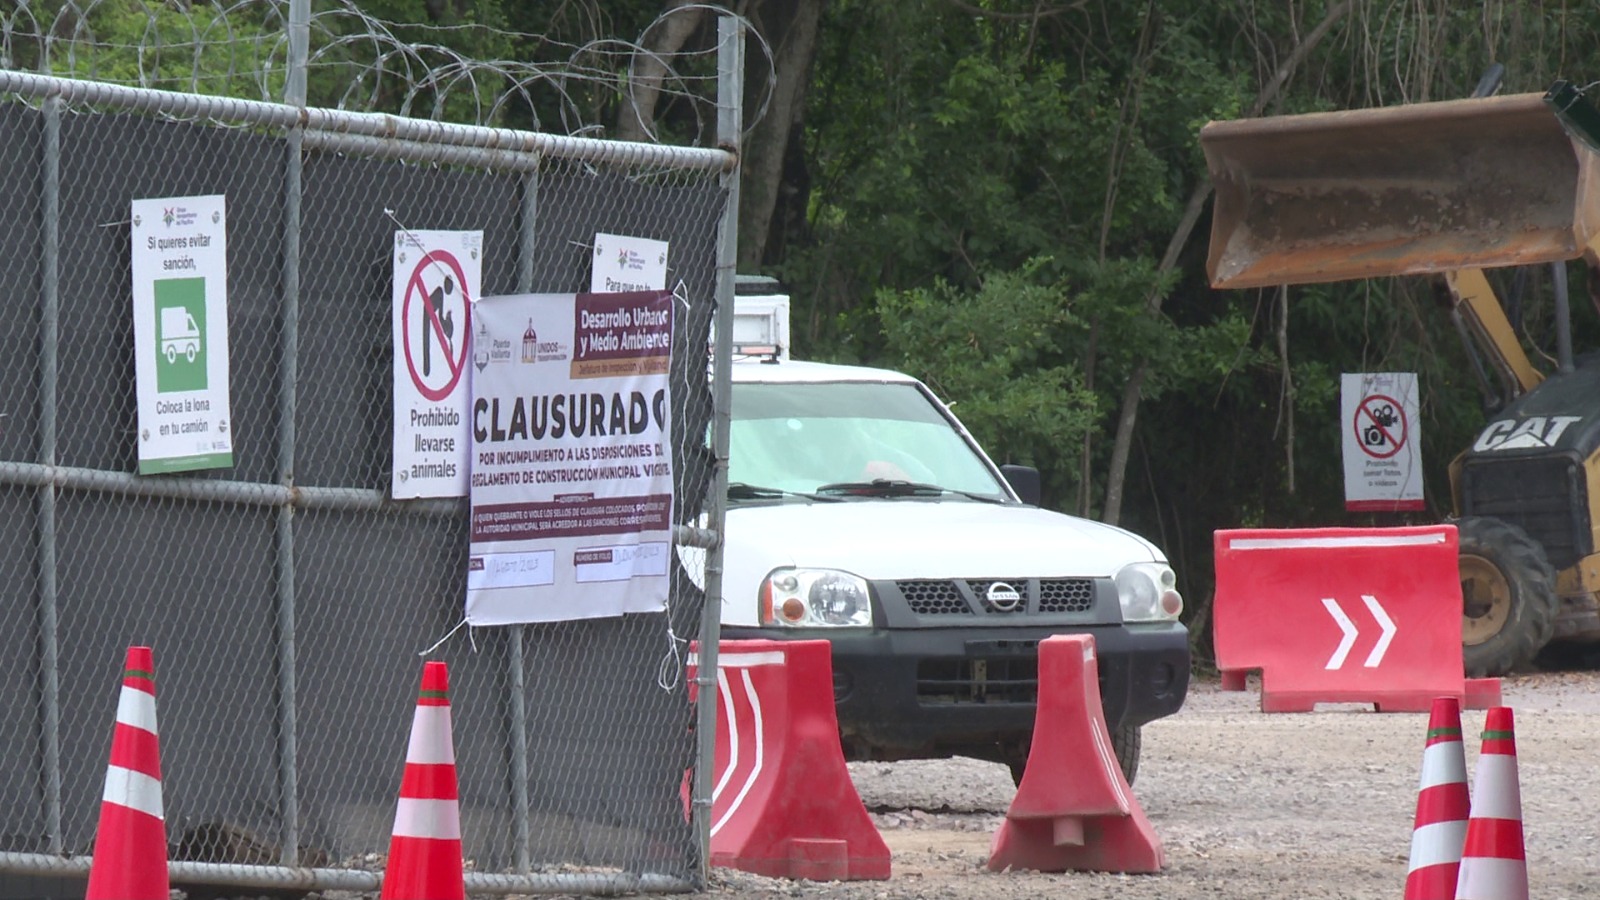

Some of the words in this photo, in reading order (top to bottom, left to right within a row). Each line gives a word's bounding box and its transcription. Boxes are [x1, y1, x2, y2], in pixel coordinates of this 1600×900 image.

[147, 236, 156, 250] Si
[158, 236, 187, 252] quieres
[189, 233, 211, 248] evitar
[163, 255, 197, 271] sanción,
[606, 276, 620, 292] Para
[581, 307, 631, 329] Desarrollo
[538, 342, 558, 353] UNIDOS
[580, 337, 588, 358] y
[590, 329, 619, 352] Medio
[156, 401, 183, 415] Coloca
[184, 399, 191, 412] la
[193, 398, 210, 411] lona
[410, 406, 460, 427] Prohibido
[159, 424, 169, 436] en
[171, 421, 179, 435] tu
[181, 418, 208, 434] camión
[1473, 416, 1583, 452] CAT
[415, 433, 455, 452] llevarse
[479, 453, 495, 466] POR
[497, 449, 565, 465] INCUMPLIMIENTO
[567, 448, 574, 461] A
[575, 447, 590, 461] LAS
[592, 444, 652, 460] DISPOSICIONES
[411, 458, 456, 478] animales
[523, 471, 534, 484] DE
[536, 465, 598, 483] CONSTRUCCIÓN
[600, 464, 641, 480] MUNICIPAL
[479, 513, 493, 523] QUIEN
[494, 511, 523, 522] QUEBRANTE
[524, 510, 528, 519] O
[529, 509, 543, 519] VIOLE
[544, 508, 553, 518] LOS
[554, 507, 571, 517] SELLOS
[572, 507, 579, 516] DE
[580, 506, 605, 516] CLAUSURA
[606, 503, 635, 514] COLOCADOS
[476, 526, 482, 534] LA
[483, 523, 510, 533] AUTORIDAD
[511, 522, 538, 532] MUNICIPAL
[552, 519, 577, 530] ACREEDOR
[583, 518, 592, 527] LAS
[593, 517, 619, 527] SANCIONES
